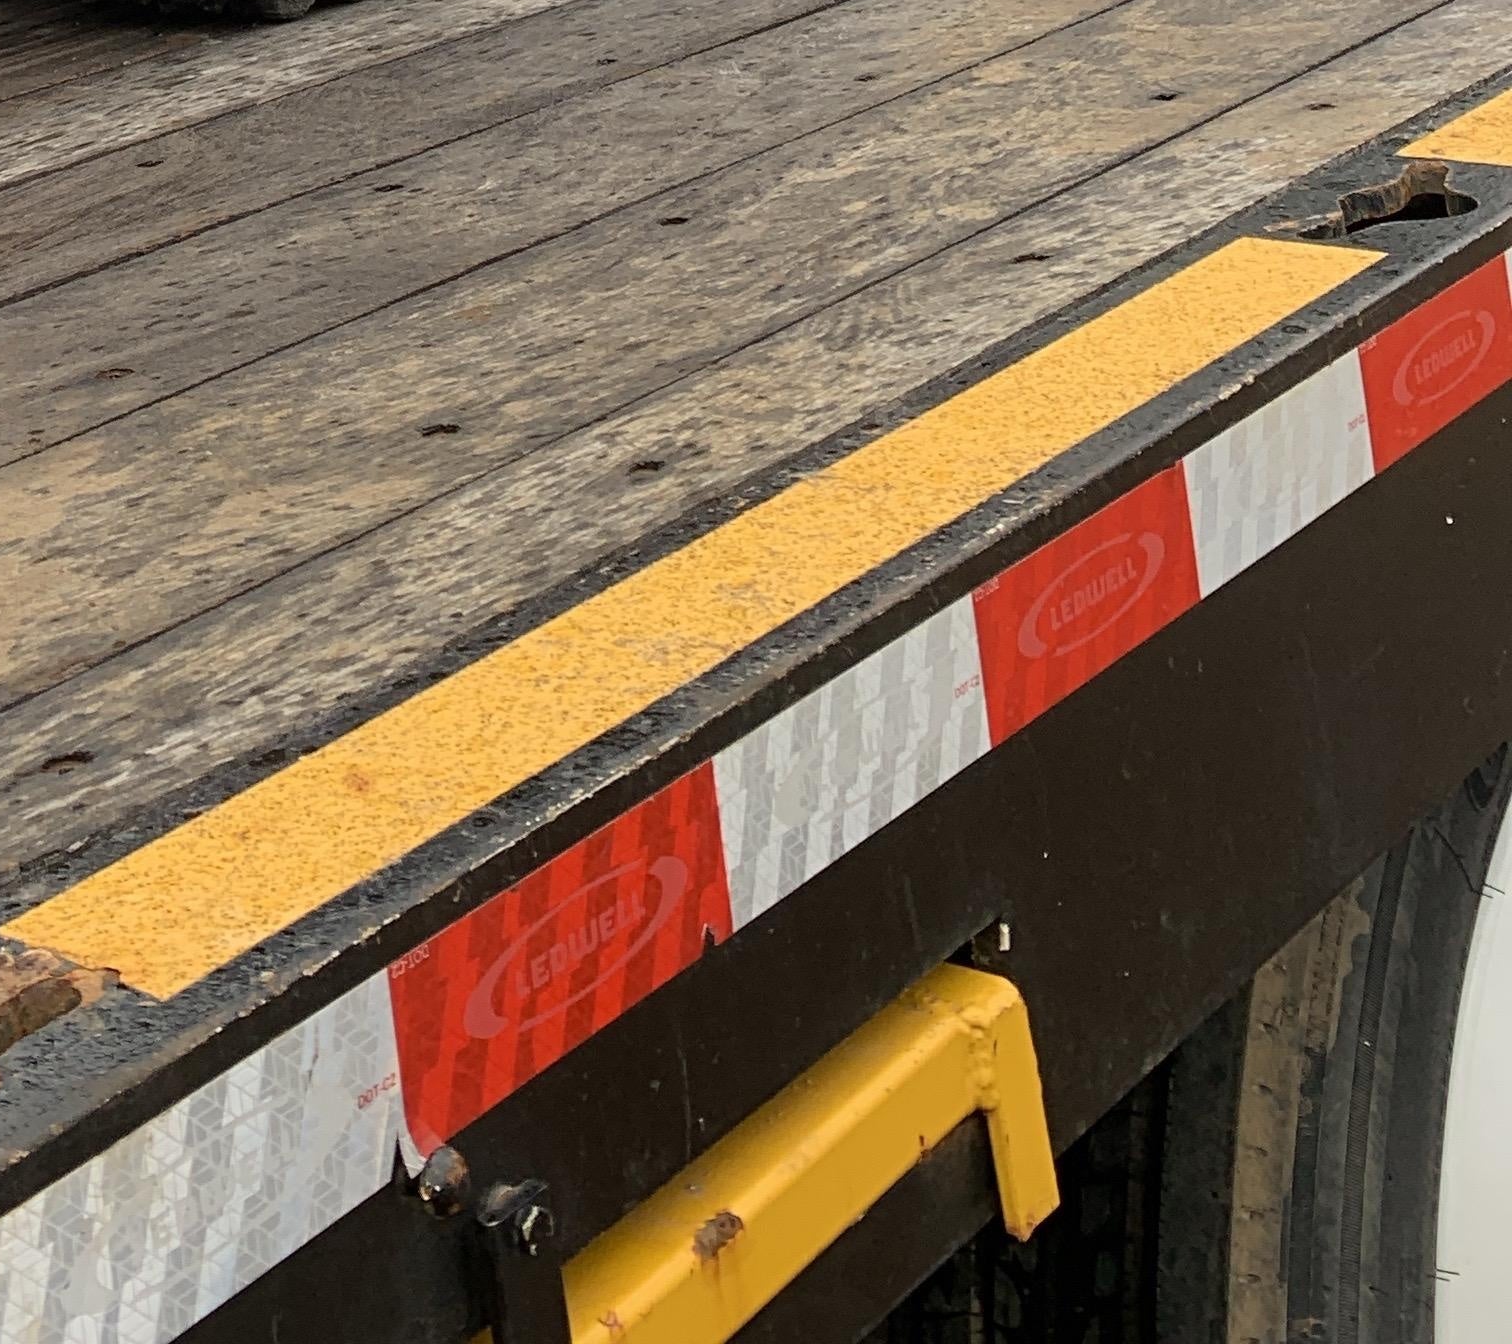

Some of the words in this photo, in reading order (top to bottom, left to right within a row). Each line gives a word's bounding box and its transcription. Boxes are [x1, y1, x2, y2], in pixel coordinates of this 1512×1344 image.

[1415, 329, 1476, 385] LEDWELL
[1050, 557, 1137, 631] LEDWELL
[515, 891, 646, 998] LEDWELL
[357, 1072, 397, 1110] DOT-C2
